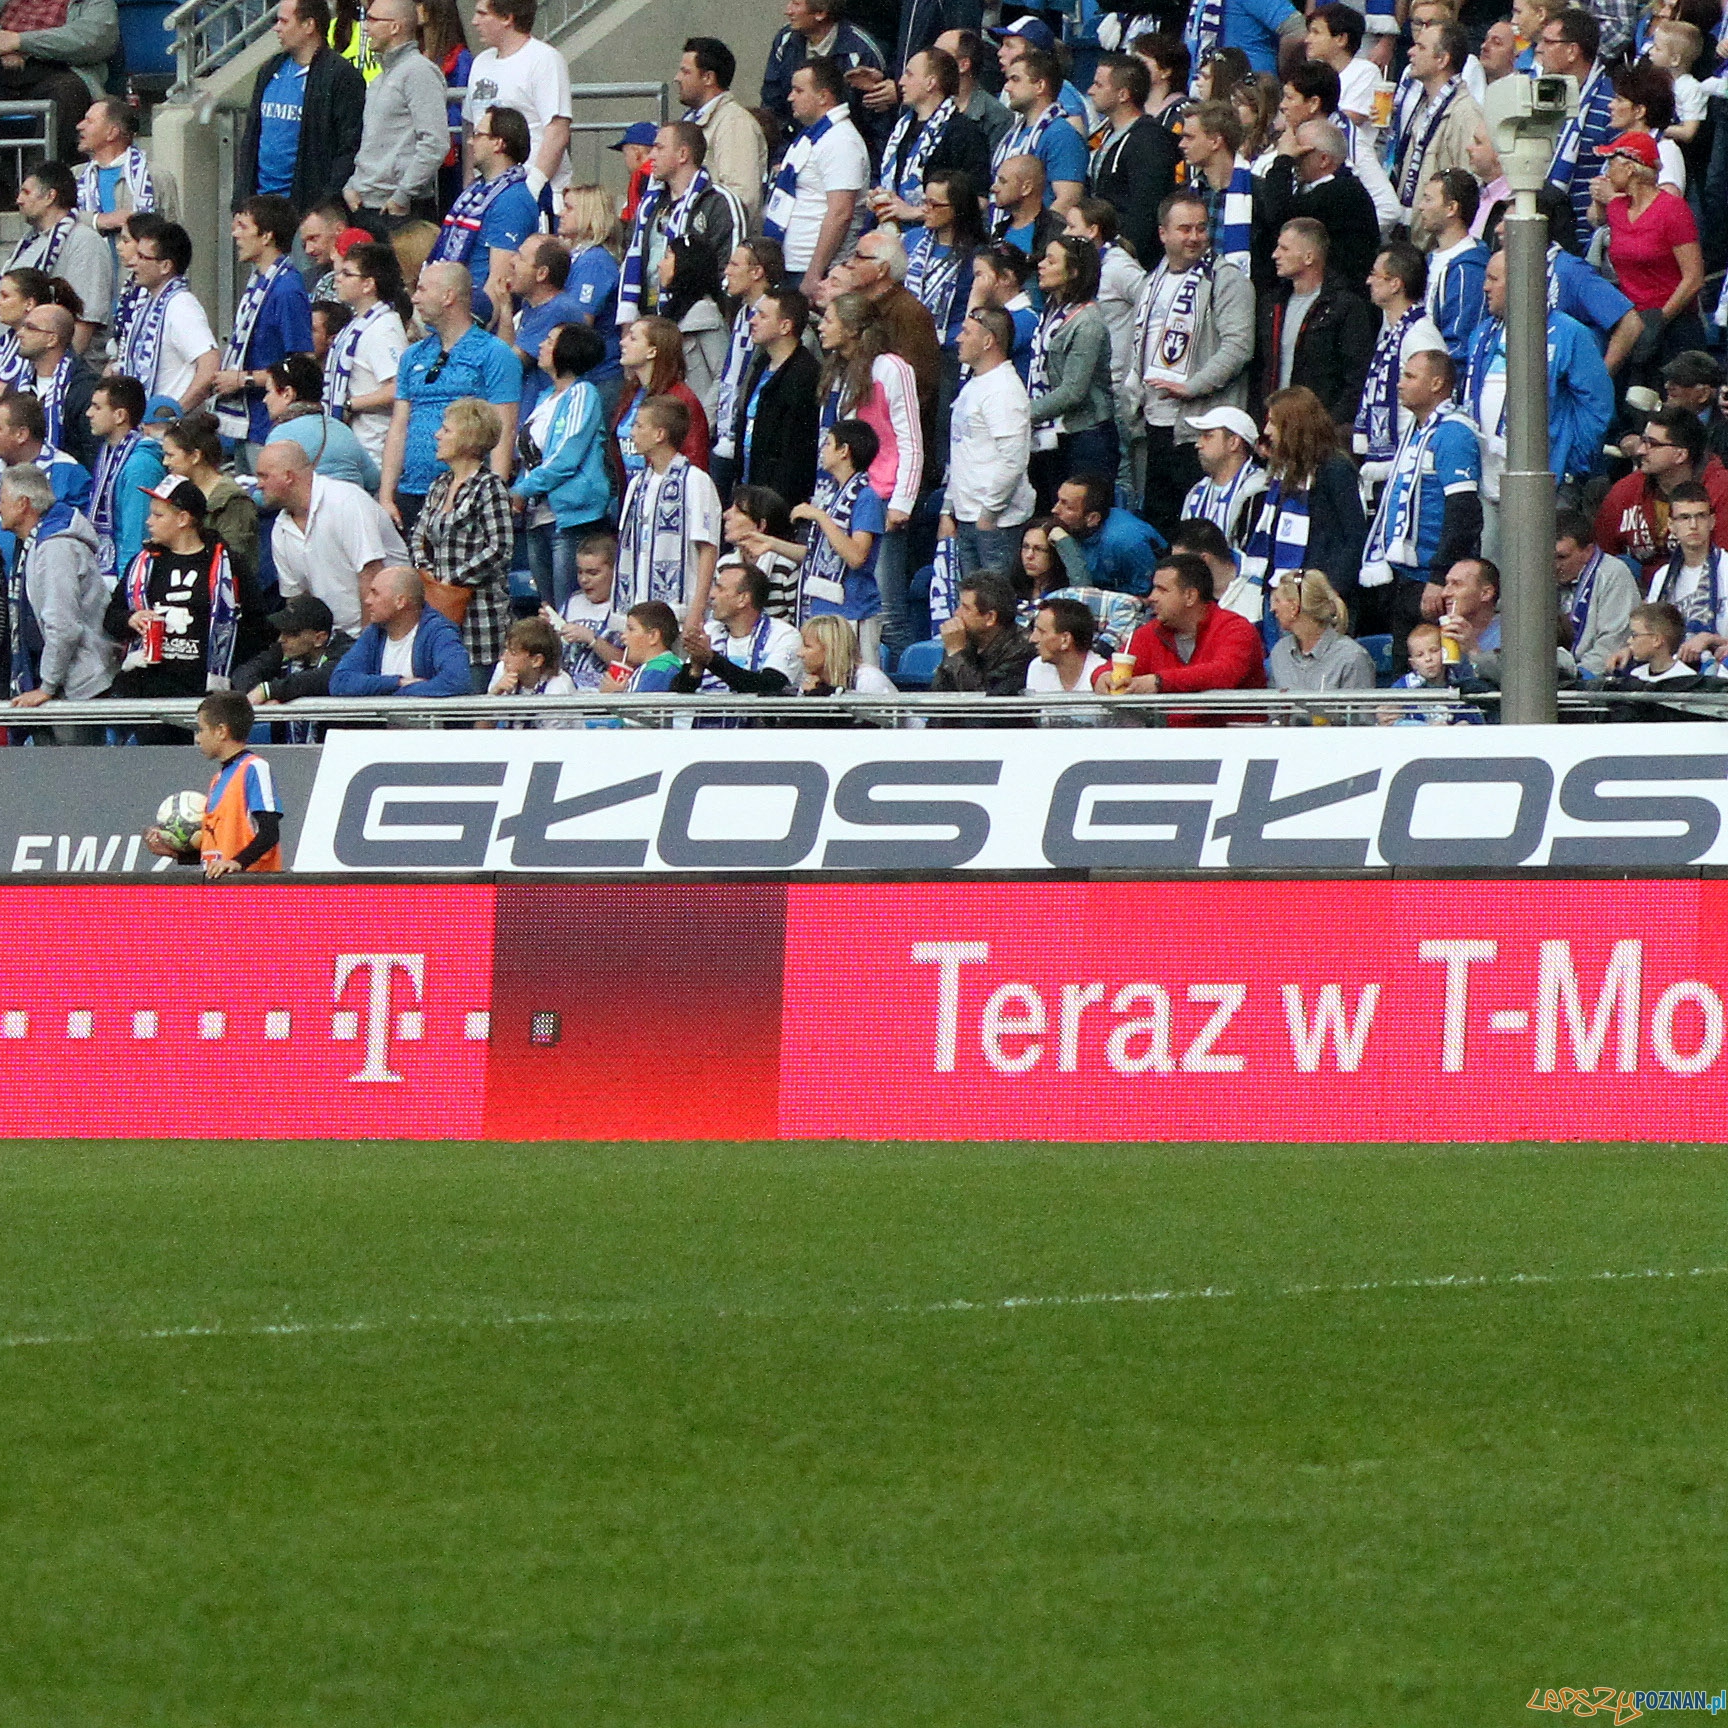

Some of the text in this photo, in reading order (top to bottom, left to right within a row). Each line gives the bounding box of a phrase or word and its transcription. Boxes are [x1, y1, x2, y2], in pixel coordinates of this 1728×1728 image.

[262, 103, 304, 122] REMES
[333, 755, 1728, 869] GŁOS GŁOS
[910, 938, 1725, 1075] Teraz w T-Mo
